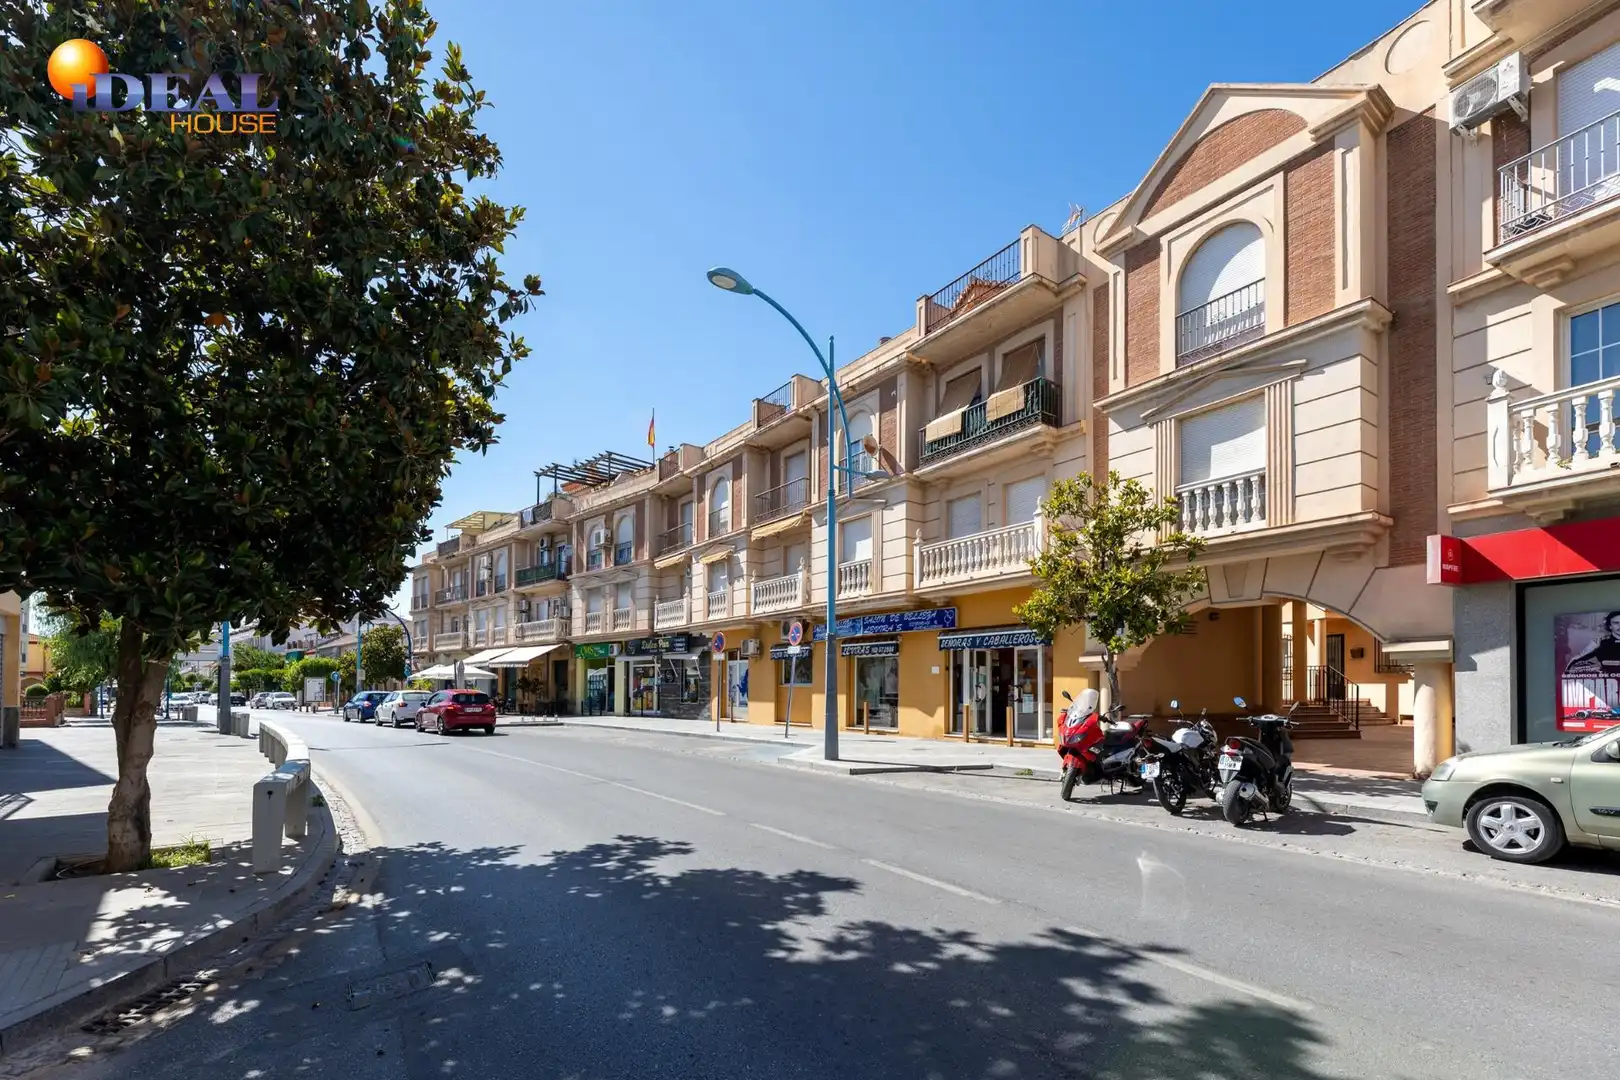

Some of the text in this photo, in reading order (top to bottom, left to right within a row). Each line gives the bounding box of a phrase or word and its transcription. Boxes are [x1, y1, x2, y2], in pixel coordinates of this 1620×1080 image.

[889, 613, 900, 622] DE
[976, 637, 982, 646] Y
[983, 632, 1036, 646] CABALLEROS
[1562, 679, 1620, 708] IMPAR
